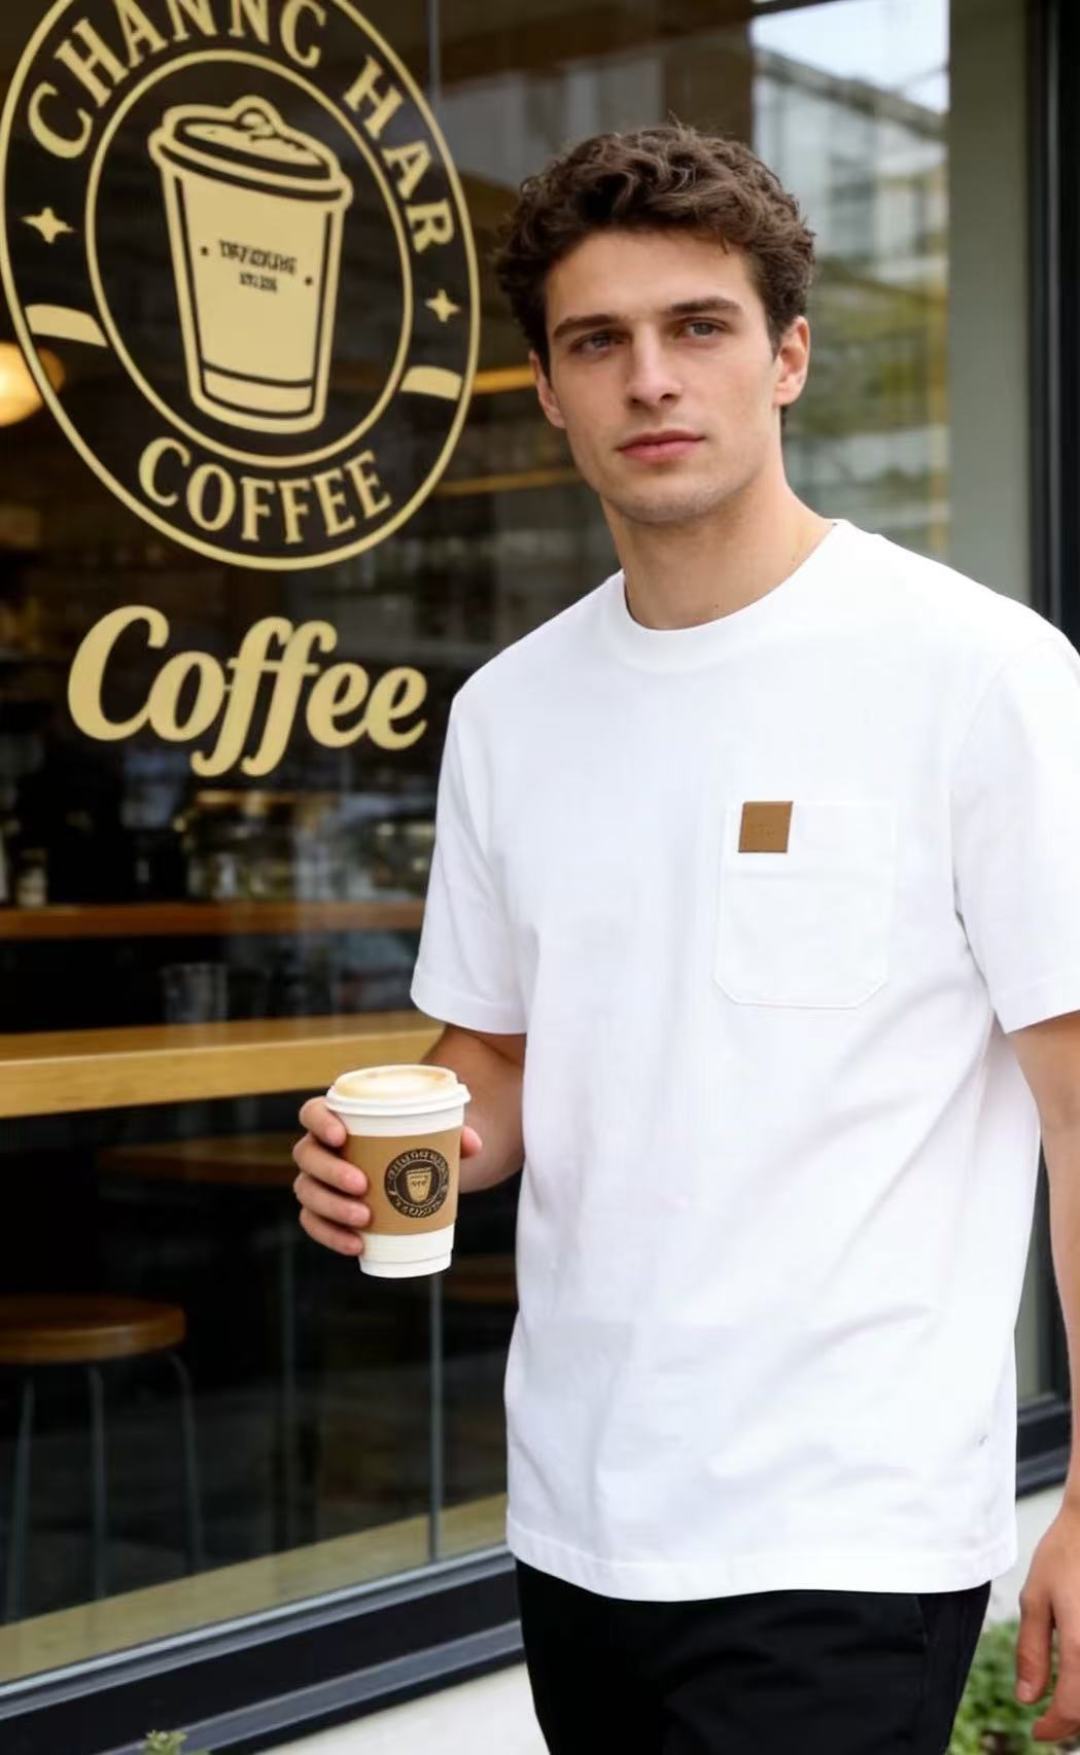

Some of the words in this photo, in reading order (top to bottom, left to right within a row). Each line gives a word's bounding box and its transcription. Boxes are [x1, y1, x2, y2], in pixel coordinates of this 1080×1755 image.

[344, 55, 454, 253] HAR
[138, 437, 391, 544] COFFEE
[68, 605, 428, 777] Coffee
